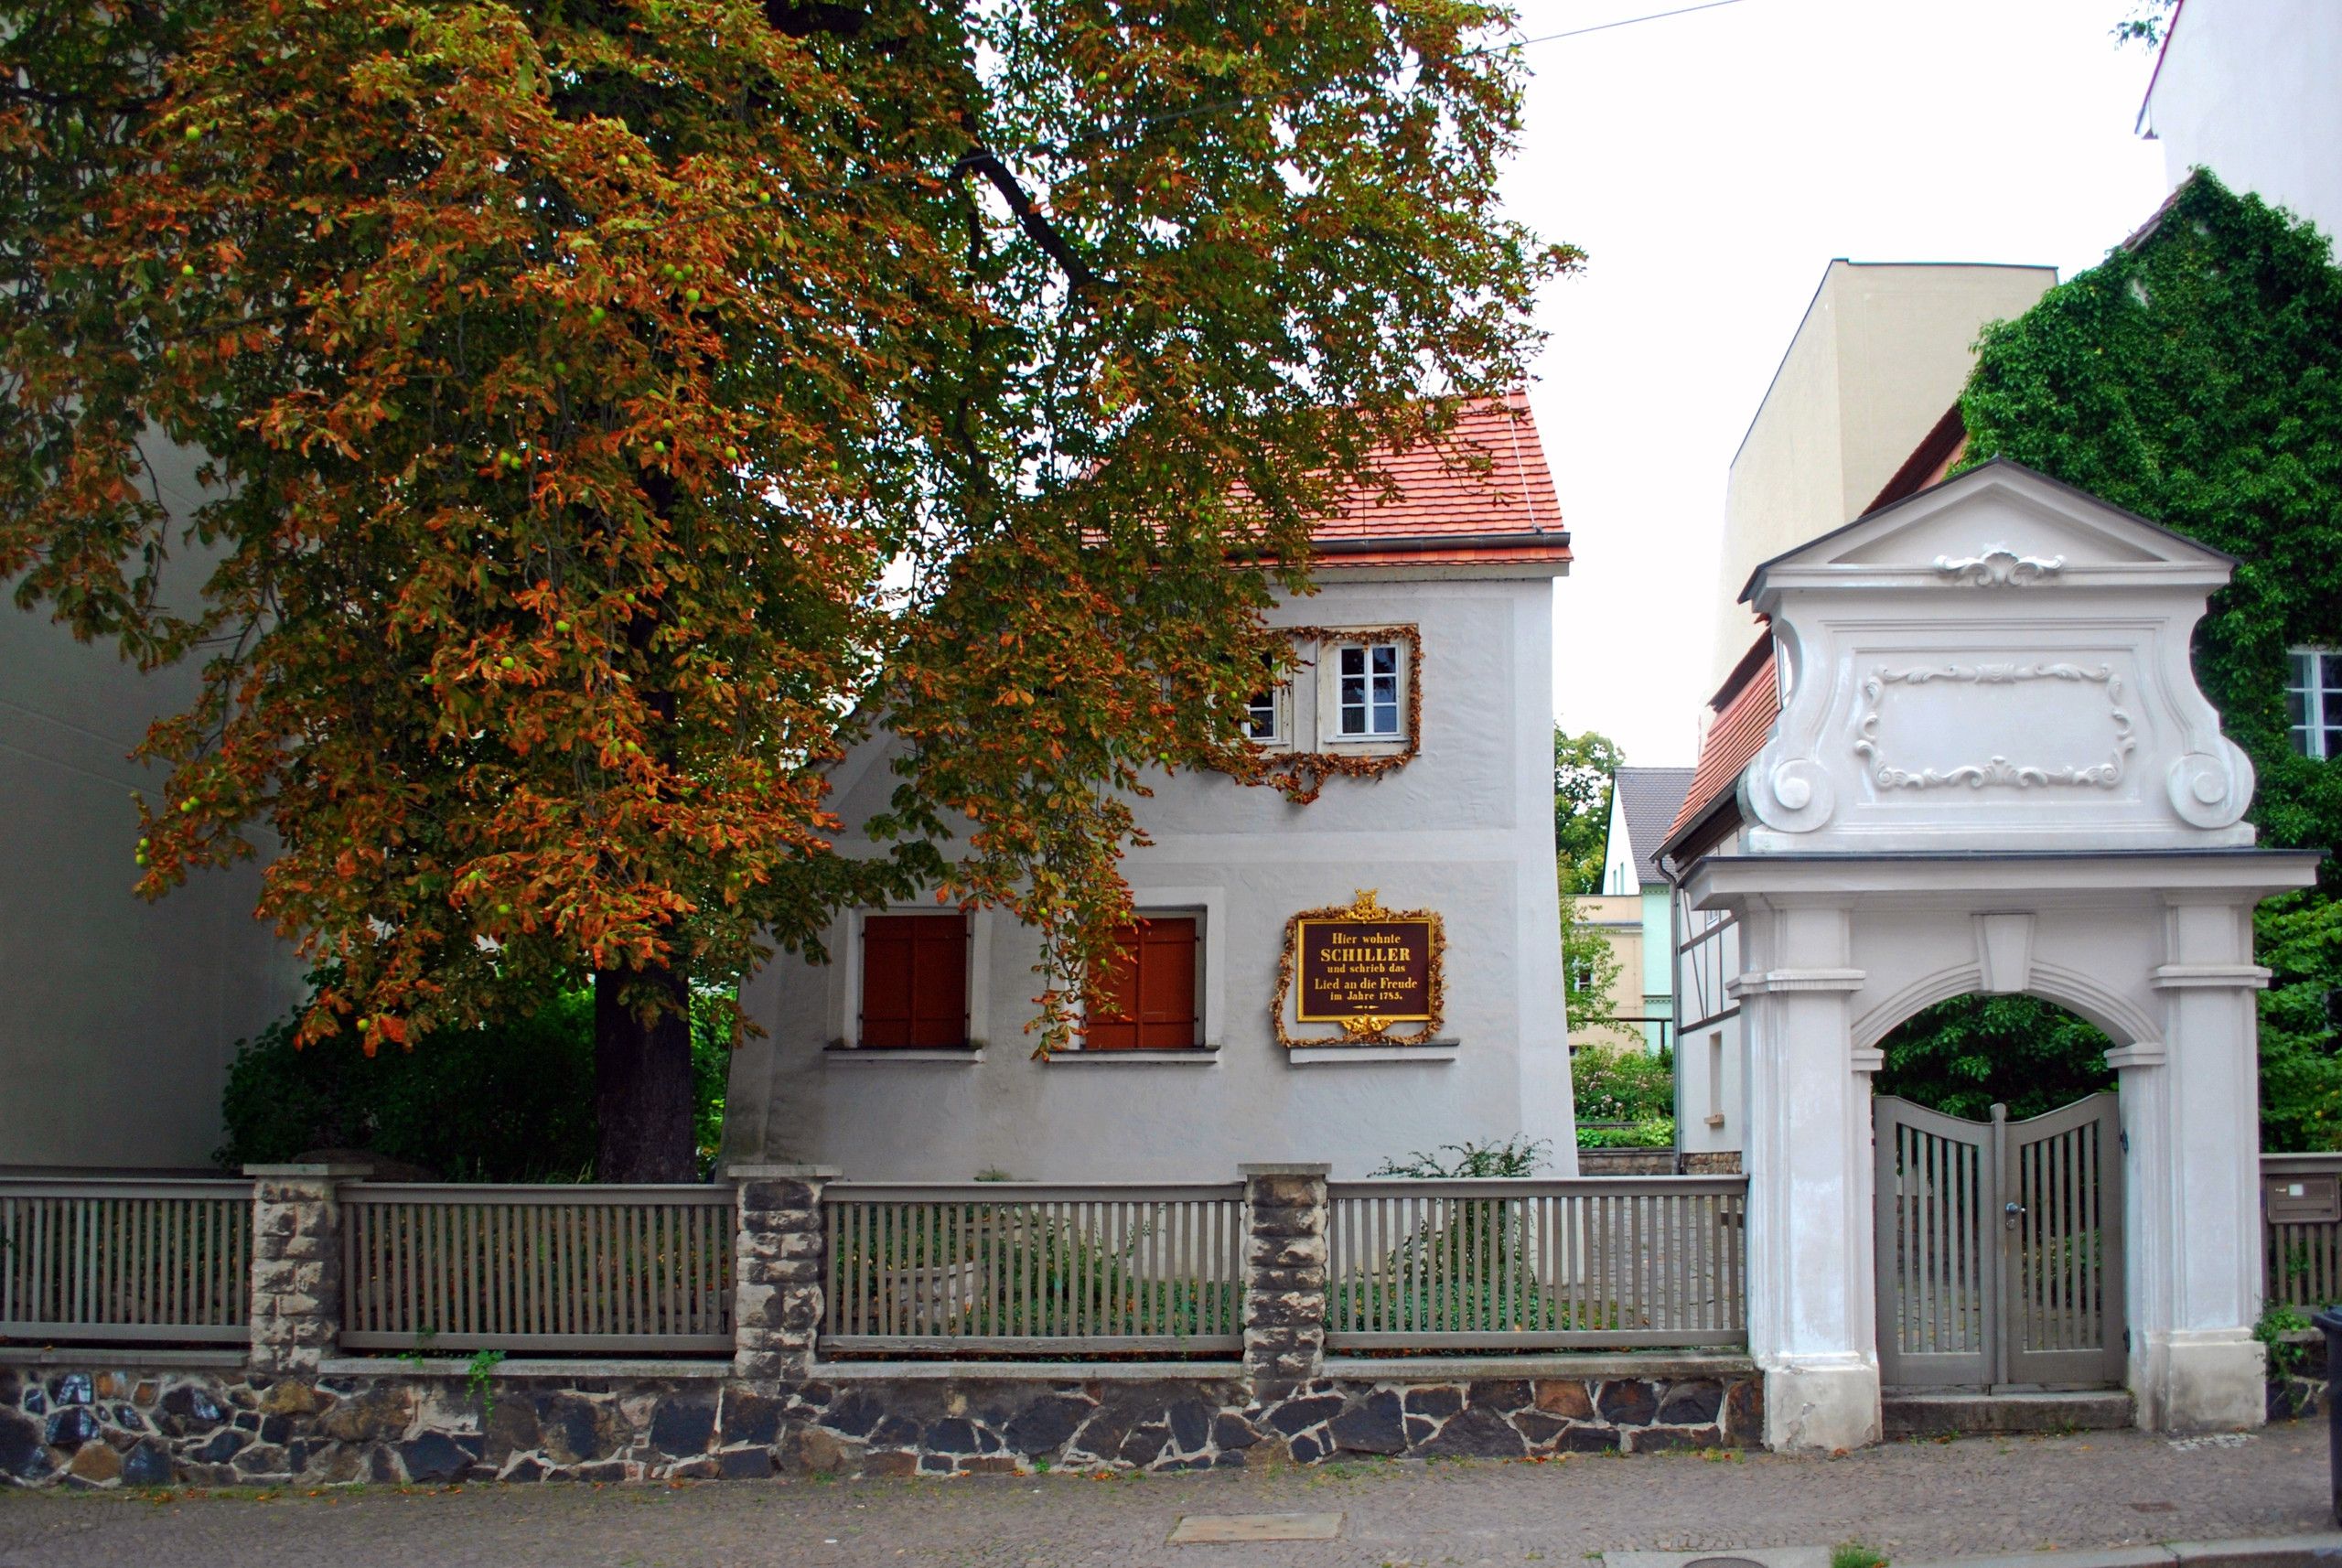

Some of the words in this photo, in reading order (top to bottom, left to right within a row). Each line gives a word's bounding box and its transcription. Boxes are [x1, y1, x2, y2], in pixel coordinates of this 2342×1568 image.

[1332, 932, 1358, 944] Hier
[1362, 932, 1402, 944] wohnte
[1320, 948, 1411, 961] SCHILLER
[1327, 963, 1346, 973] und
[1349, 963, 1386, 972] schrieb
[1389, 962, 1406, 972] das
[1315, 978, 1339, 990] Lied
[1359, 977, 1377, 989] die
[1380, 977, 1418, 989] Freude
[1330, 992, 1342, 1001] im
[1347, 991, 1375, 1001] Jahre
[1380, 992, 1403, 1001] 1785.
